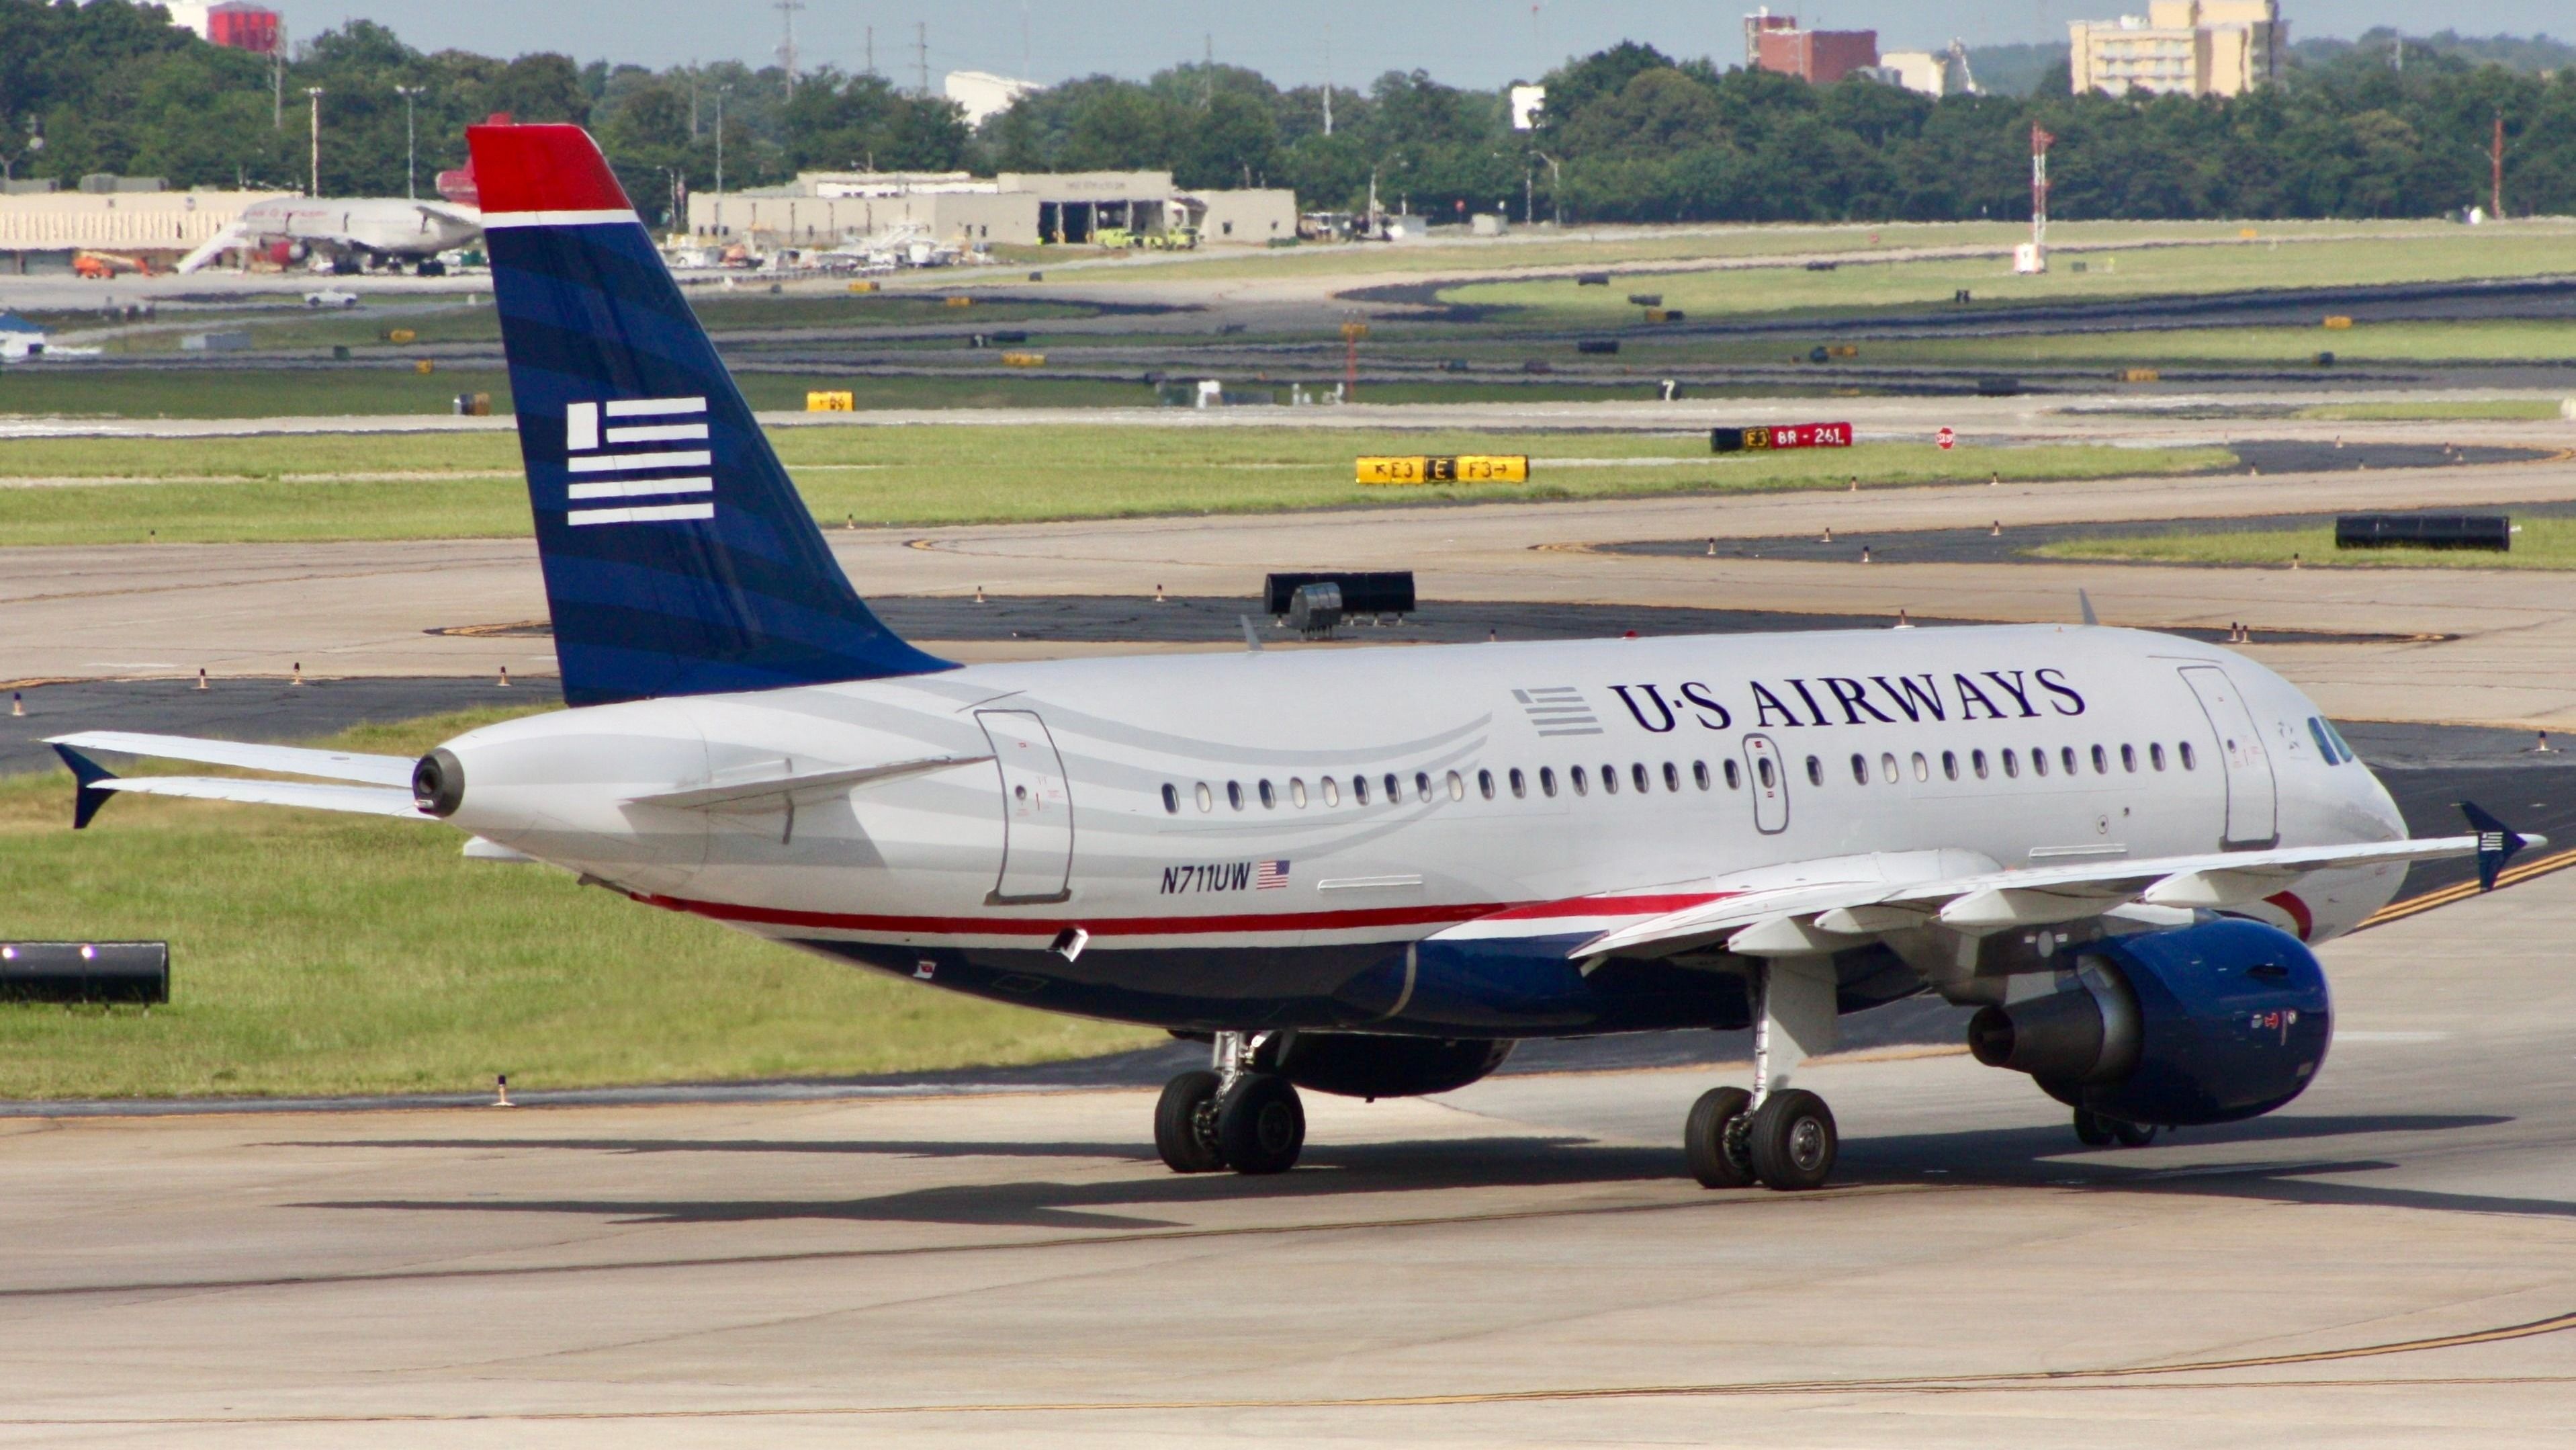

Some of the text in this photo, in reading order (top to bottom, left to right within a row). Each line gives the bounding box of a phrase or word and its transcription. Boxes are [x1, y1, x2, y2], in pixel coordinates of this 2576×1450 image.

[1662, 380, 1675, 402] 7
[1747, 431, 1769, 447] E3
[1814, 427, 1845, 443] 26L
[1391, 460, 1492, 479] E3 E F3
[1749, 668, 2086, 727] AIRWAYS
[1160, 861, 1251, 894] N711UW
